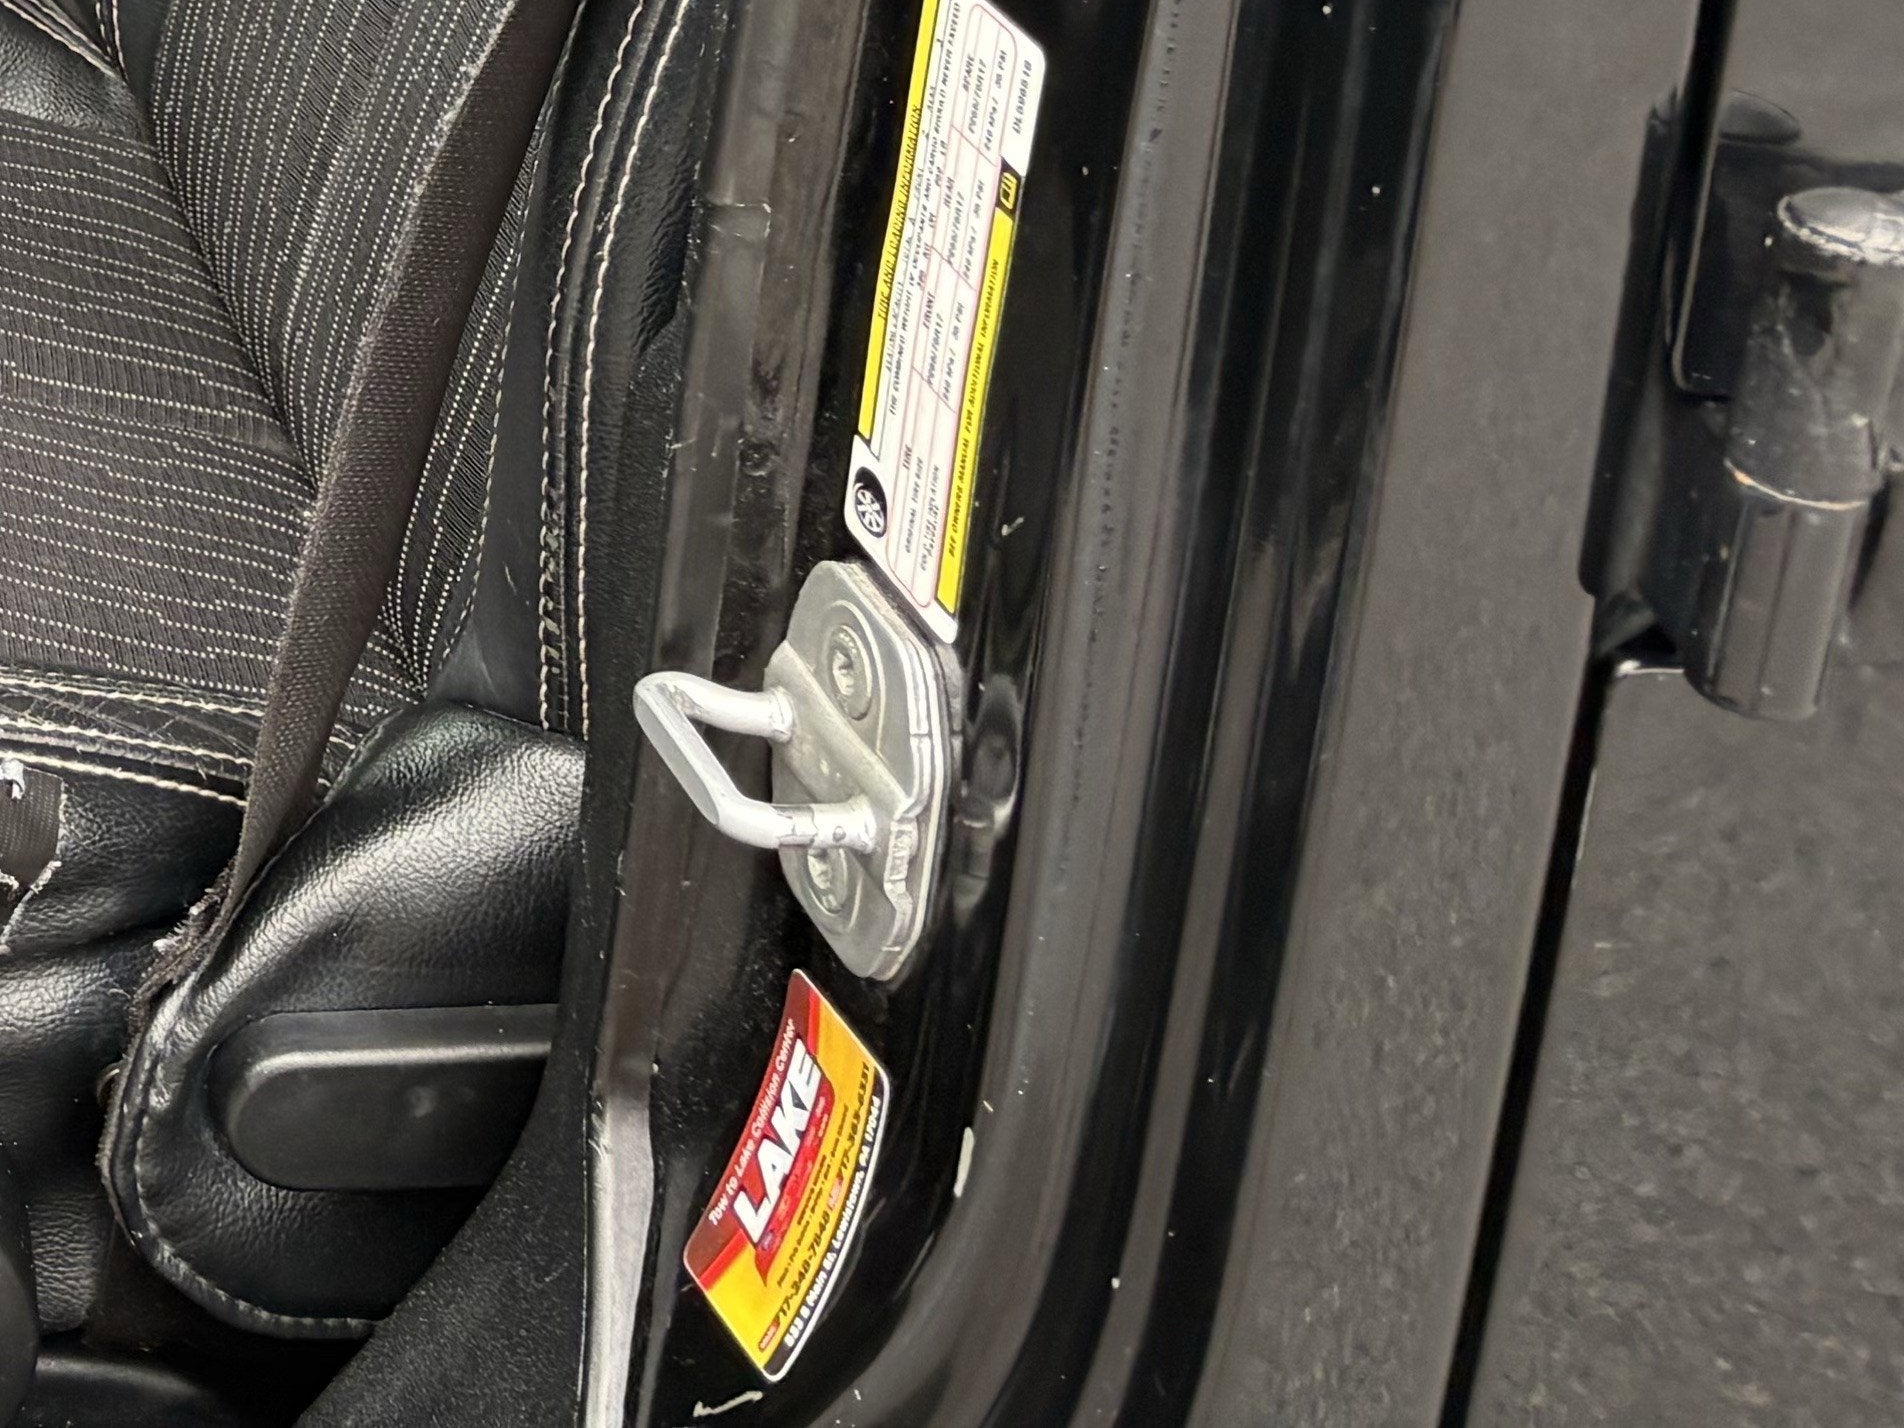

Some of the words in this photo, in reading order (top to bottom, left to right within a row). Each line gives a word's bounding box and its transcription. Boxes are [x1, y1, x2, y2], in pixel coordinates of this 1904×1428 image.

[709, 1193, 729, 1226] Tow
[726, 1176, 738, 1195] to
[735, 1139, 755, 1178] Lake
[752, 1073, 780, 1138] Collision
[775, 1018, 796, 1072] Center
[733, 1038, 822, 1243] LAKE
[806, 1271, 827, 1306] Main
